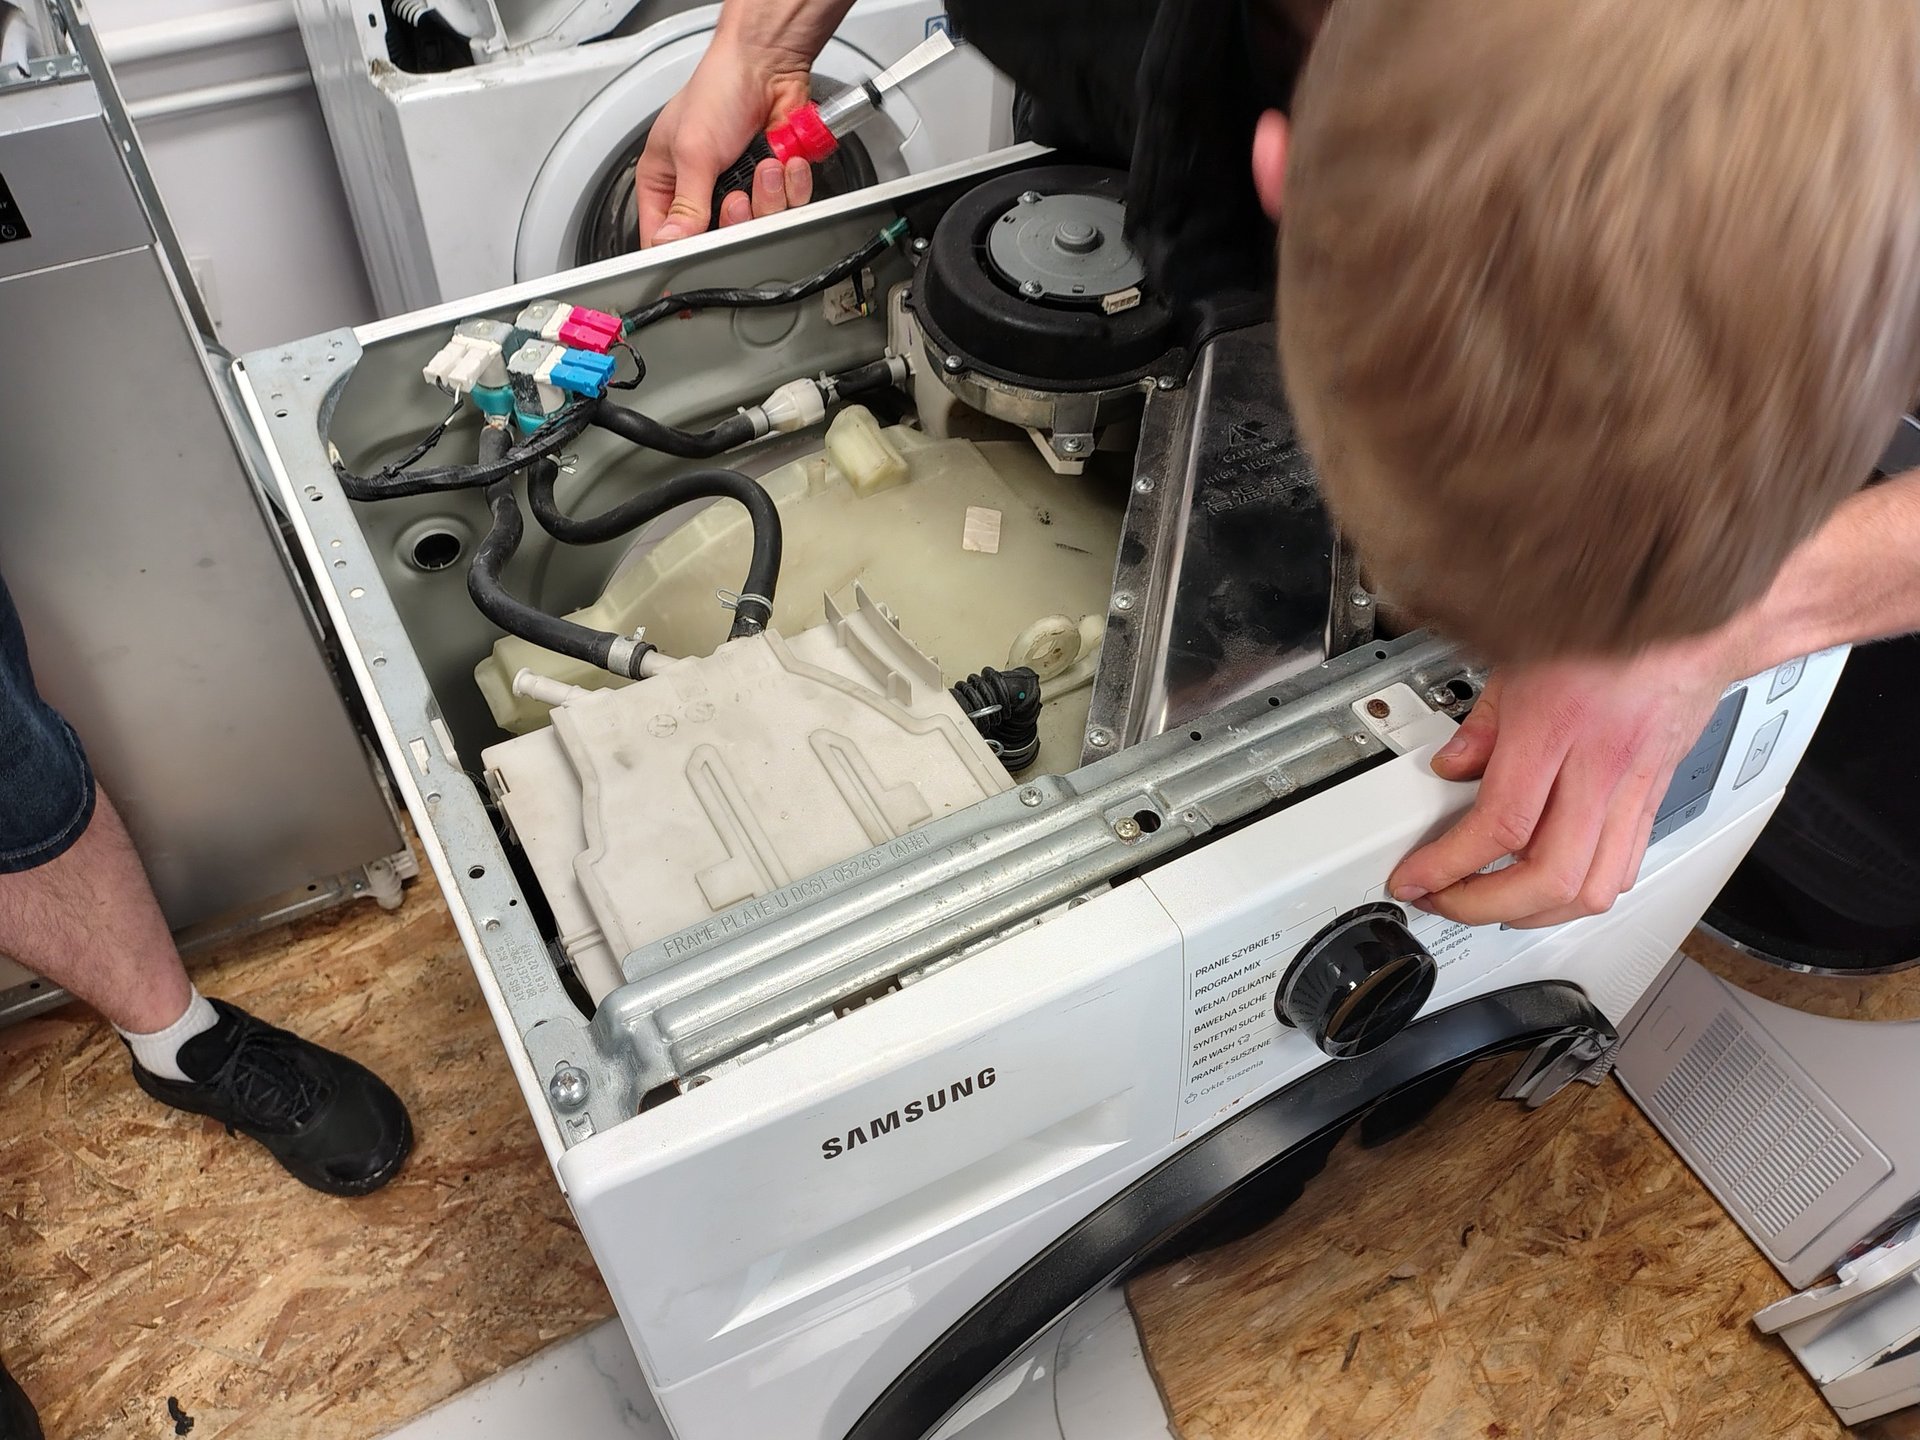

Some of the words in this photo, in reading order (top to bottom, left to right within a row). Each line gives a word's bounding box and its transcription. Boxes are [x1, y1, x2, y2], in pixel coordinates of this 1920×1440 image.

[662, 922, 720, 959] FRAME
[720, 899, 775, 933] PLATE
[775, 892, 790, 909] U
[1195, 954, 1230, 978] PRANIE
[1231, 936, 1269, 960] SZYBKIE
[1194, 969, 1242, 998] PROGRAM
[1243, 959, 1261, 974] MIX
[1193, 1024, 1237, 1052] SYNTETYKI
[1238, 1009, 1267, 1029] SUCHE
[1194, 1008, 1238, 1034] BAWEŁNA
[1238, 992, 1267, 1012] SUCHE
[1190, 1063, 1224, 1084] PRANIE
[1230, 1037, 1272, 1063] SUSZENIE
[1191, 1055, 1208, 1068] AIR
[1208, 1041, 1235, 1059] WASH
[1200, 1081, 1225, 1096] Cykle
[1226, 1060, 1264, 1083] Suszenia
[821, 1067, 997, 1160] SAMSUNG
